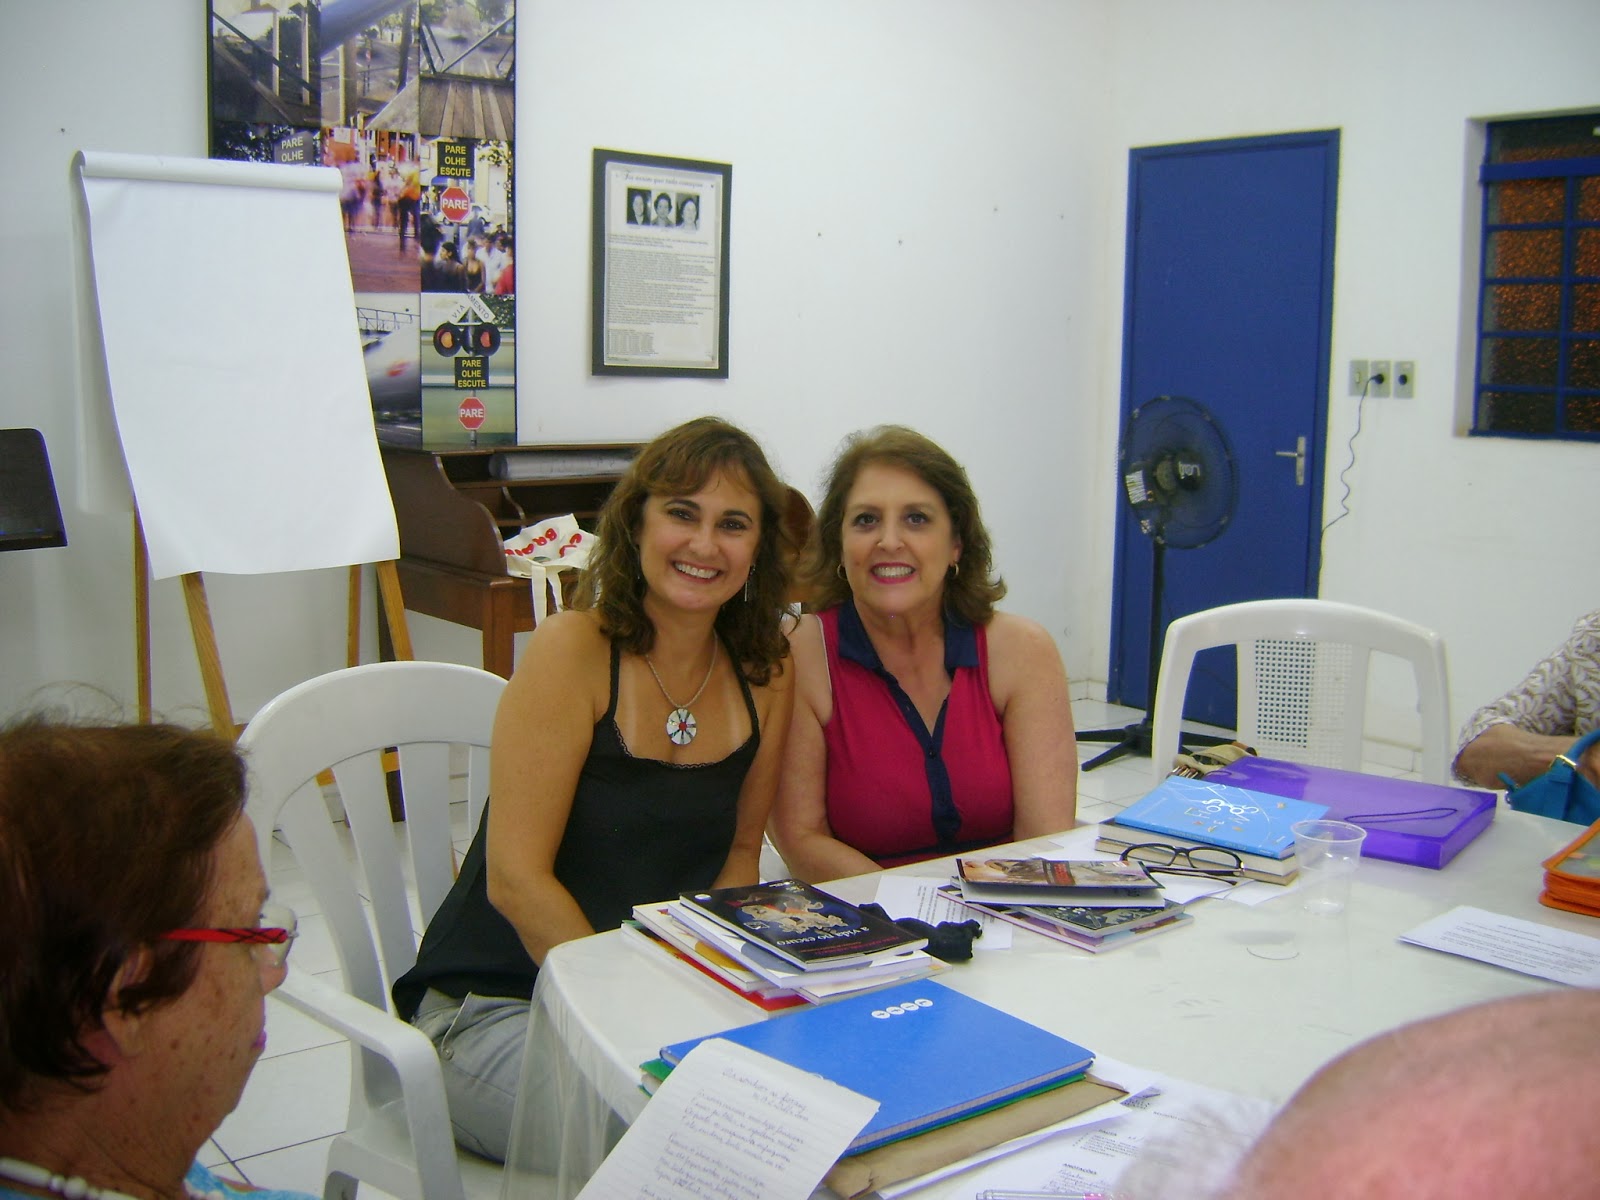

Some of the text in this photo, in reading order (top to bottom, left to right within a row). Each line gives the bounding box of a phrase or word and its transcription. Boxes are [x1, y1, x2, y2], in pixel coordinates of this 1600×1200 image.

[281, 136, 304, 150] PARE
[445, 145, 467, 155] PARE
[281, 150, 304, 162] OLHE
[444, 157, 467, 166] OLHE
[440, 167, 472, 177] ESCUTE
[442, 199, 468, 210] PARE
[461, 359, 482, 368] PARE
[461, 369, 482, 378] OLHE
[457, 379, 486, 388] ESCUTE
[460, 408, 484, 418] PARE
[836, 928, 861, 938] vida
[776, 936, 816, 946] escuro
